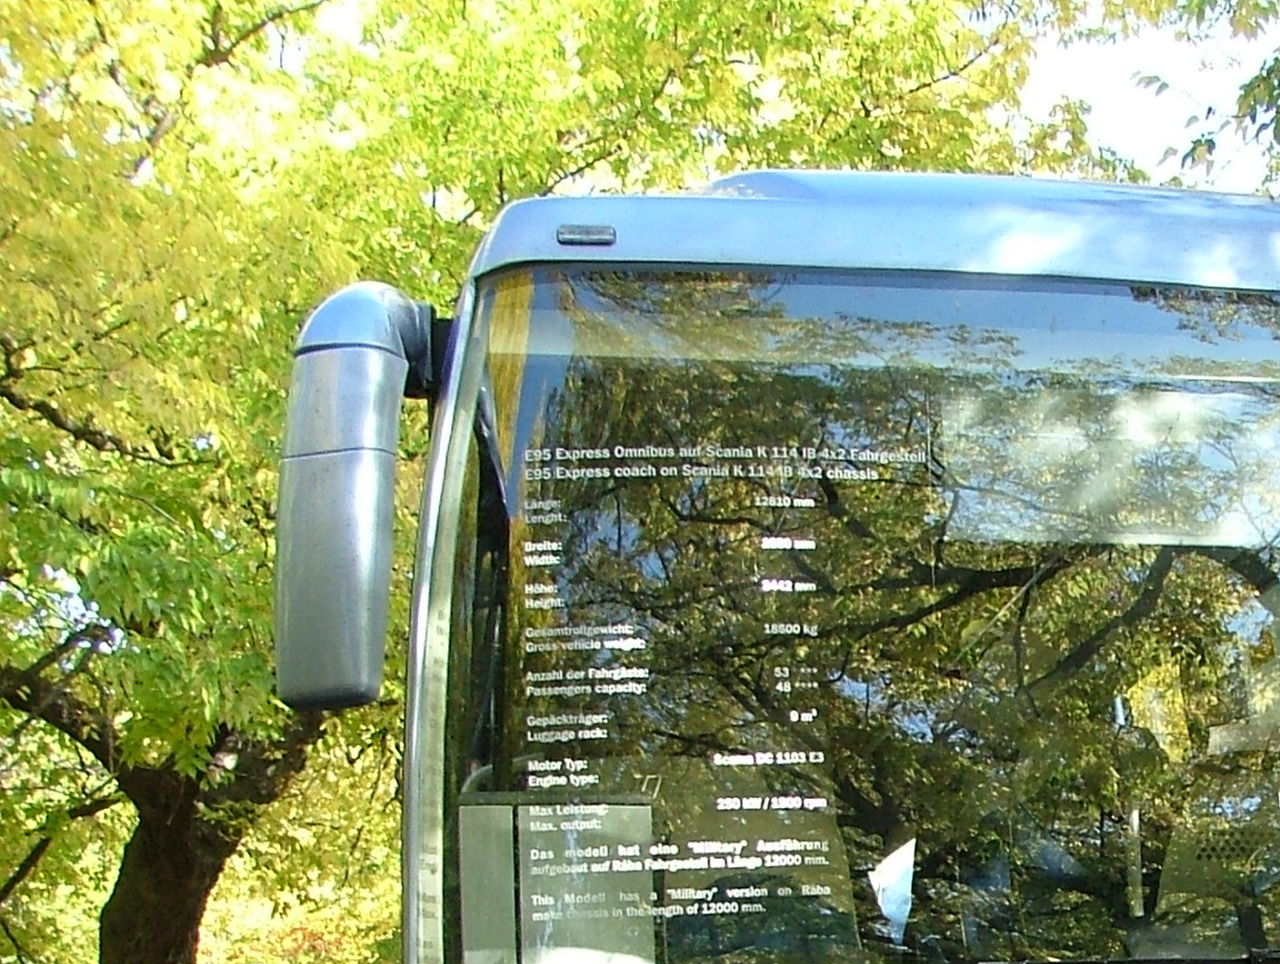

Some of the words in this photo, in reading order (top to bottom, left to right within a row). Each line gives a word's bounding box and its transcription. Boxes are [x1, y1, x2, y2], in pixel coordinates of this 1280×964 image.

[525, 449, 551, 462] E95
[556, 447, 610, 462] Express
[614, 445, 675, 458] Omnibus
[679, 446, 702, 457] auf
[706, 446, 753, 458] Scania
[757, 446, 767, 458] K
[773, 447, 798, 459] 114
[822, 448, 845, 460] 4x2
[851, 448, 926, 464] Fahrgestell
[525, 467, 551, 480] E95
[556, 466, 610, 480] Express
[614, 465, 657, 477] coach
[660, 467, 677, 477] on
[682, 464, 729, 477] Scania
[733, 466, 747, 477] K
[798, 467, 823, 479] 4x2
[827, 467, 879, 480] chassis
[755, 496, 791, 507] 12810
[793, 498, 815, 507] mm
[524, 541, 562, 551] Breite:
[524, 555, 560, 566] Width:
[525, 584, 558, 595] Höhe:
[525, 598, 565, 609] Height:
[803, 624, 818, 637] kg
[526, 642, 557, 652] Gross
[561, 640, 600, 650] vehicle
[603, 638, 646, 651] weight:
[526, 669, 563, 681] Anzahl
[566, 669, 585, 680] der
[526, 685, 592, 697] Passengers
[595, 682, 647, 696] capacity:
[527, 729, 575, 743] Luggage
[578, 728, 608, 739] rack:
[528, 760, 562, 771] Motor
[564, 758, 588, 771] Typ:
[528, 775, 567, 788] Engine
[569, 774, 599, 787] type:
[763, 797, 770, 809] /
[556, 804, 608, 816] Leistung:
[530, 821, 557, 832] Max.
[560, 819, 602, 831] output:
[531, 849, 554, 860] Das
[565, 845, 608, 858] modell
[618, 845, 640, 856] hat
[650, 844, 678, 855] eine
[531, 862, 588, 876] aufgebaut
[591, 861, 611, 872] auf
[764, 855, 802, 867] 12000
[805, 856, 829, 865] mm.
[531, 894, 554, 906] This
[564, 892, 606, 904] Modell
[619, 892, 640, 902] has
[727, 888, 768, 898] version
[778, 887, 792, 896] on
[612, 907, 623, 917] in
[627, 906, 645, 917] the
[648, 905, 683, 918] length
[686, 903, 699, 914] of
[702, 902, 738, 914] 12000
[742, 903, 766, 912] mm.
